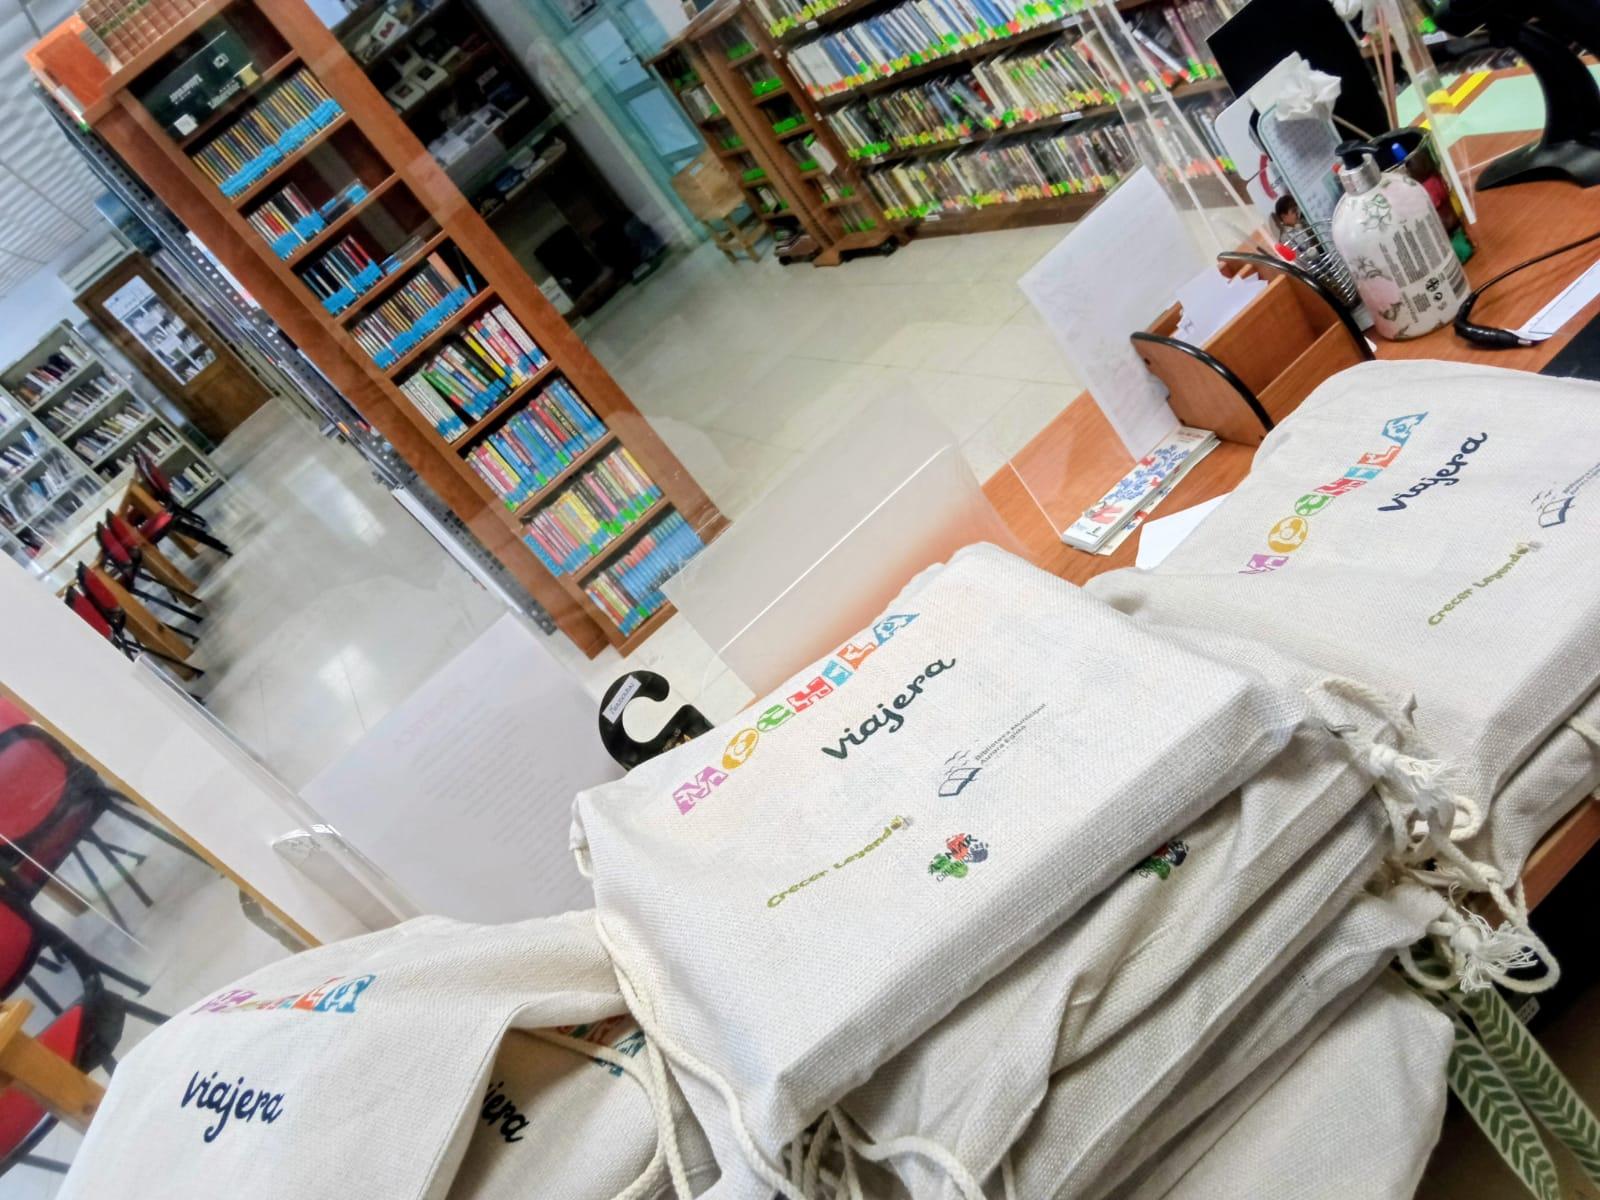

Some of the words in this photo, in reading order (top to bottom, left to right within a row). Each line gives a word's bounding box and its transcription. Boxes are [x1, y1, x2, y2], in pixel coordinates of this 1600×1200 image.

[1238, 411, 1429, 575] MOCHILA
[1377, 432, 1488, 512] viajera
[1428, 589, 1473, 626] Crecer
[672, 612, 920, 816] MOCHILA
[822, 656, 956, 760] viajera
[180, 1071, 286, 1143] viajera
